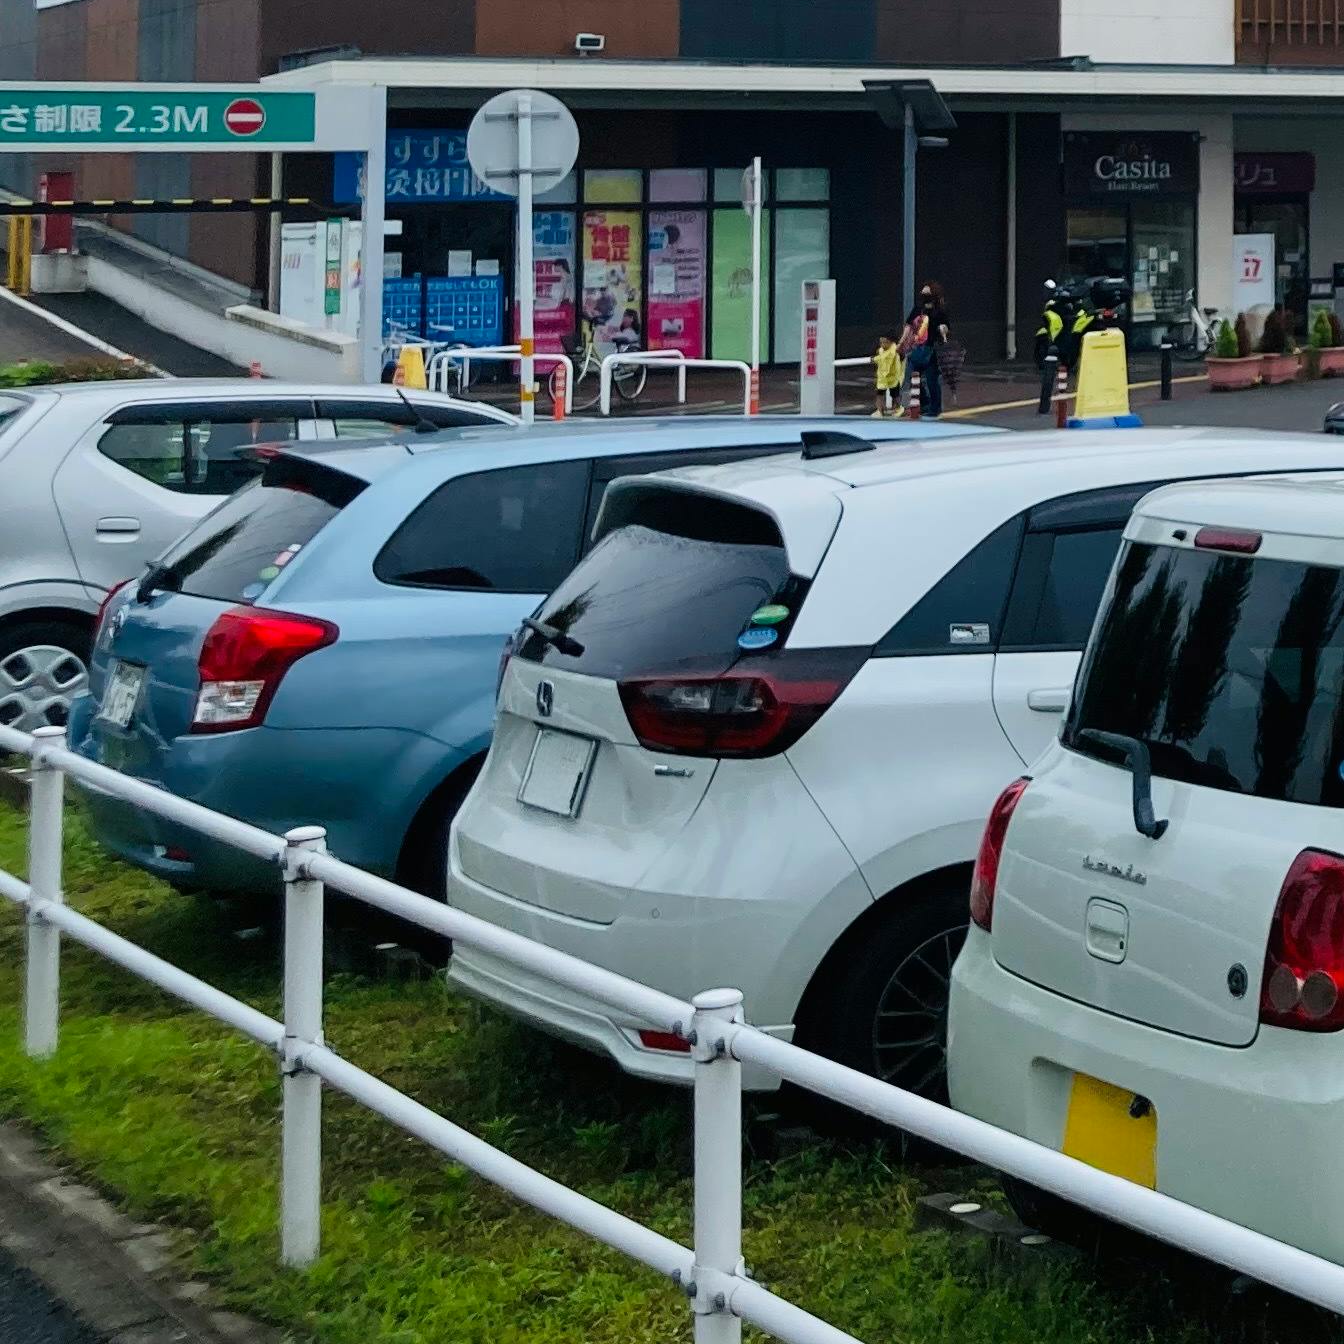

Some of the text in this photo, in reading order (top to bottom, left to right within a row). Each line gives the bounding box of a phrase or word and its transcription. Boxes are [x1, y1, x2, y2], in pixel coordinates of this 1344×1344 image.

[0, 104, 208, 133] さ制限 2.3M
[1095, 155, 1171, 180] Casita
